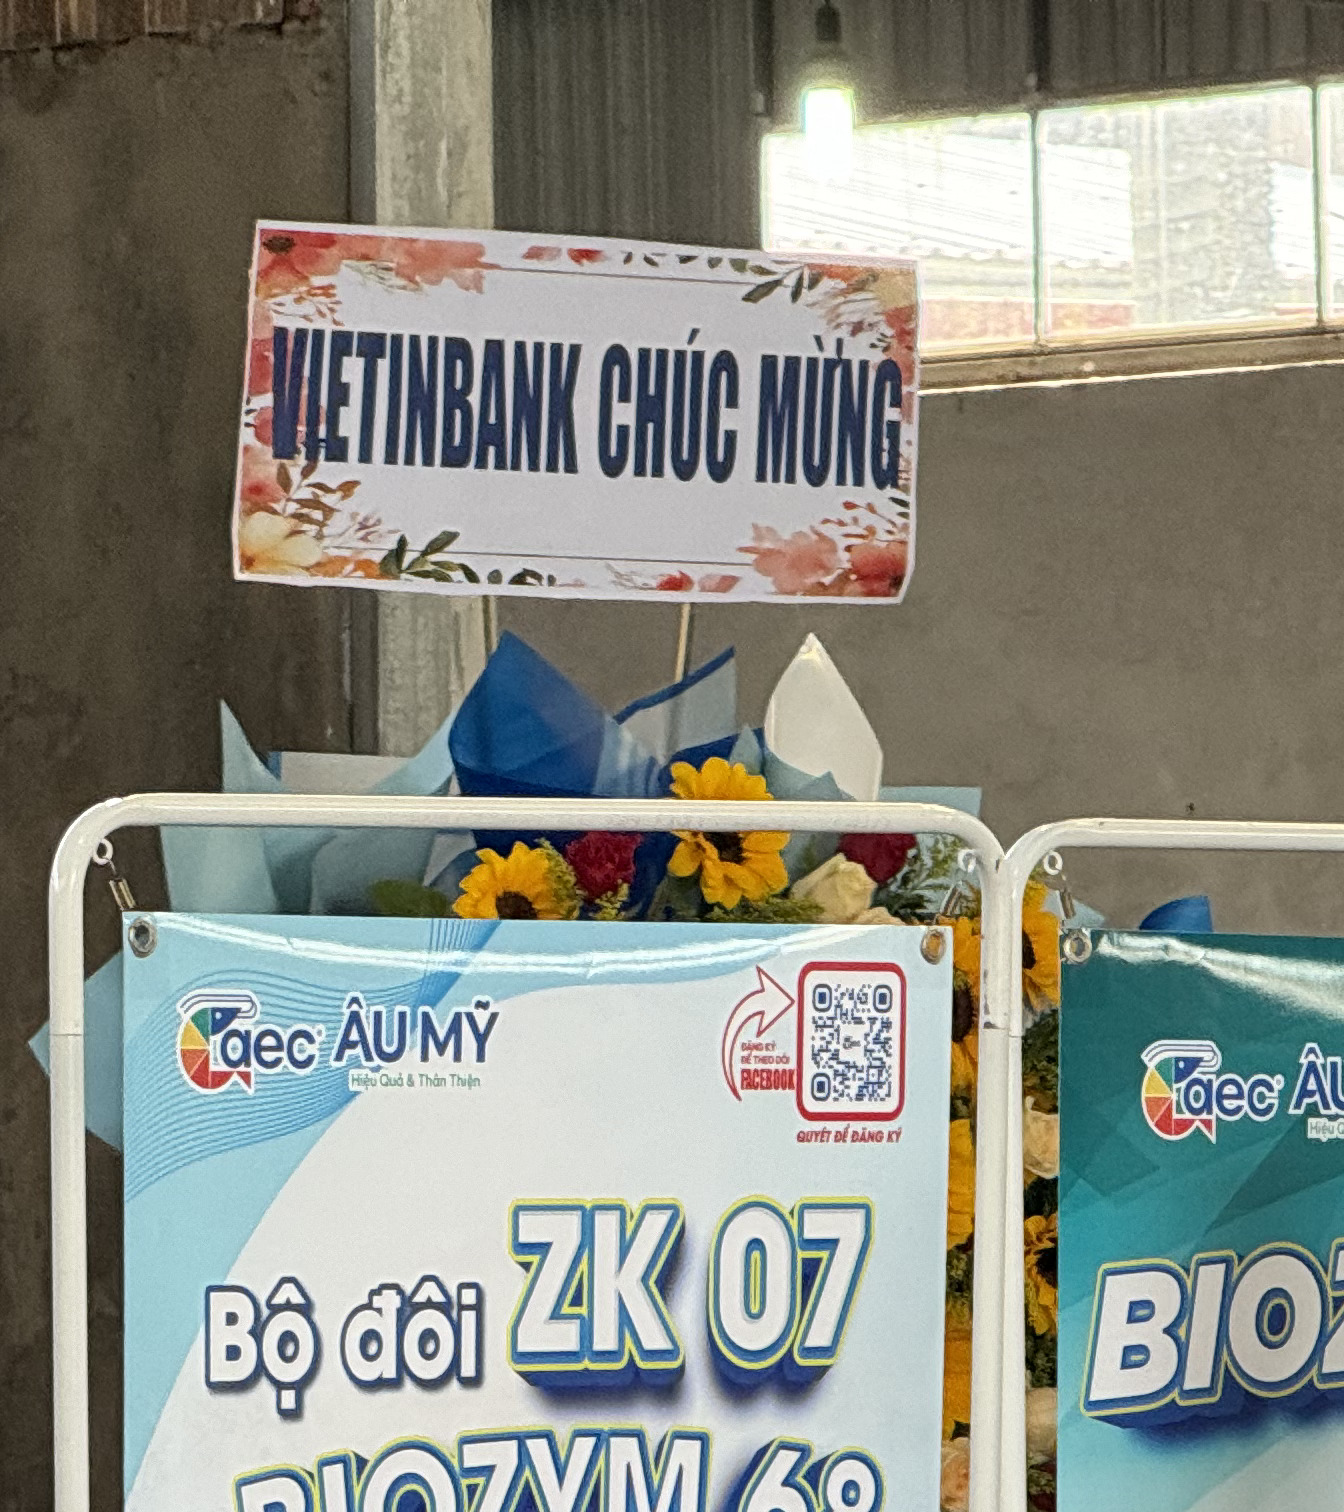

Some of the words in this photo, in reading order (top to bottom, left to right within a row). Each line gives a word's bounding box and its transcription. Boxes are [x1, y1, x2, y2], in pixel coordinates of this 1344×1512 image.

[271, 326, 582, 475] VIETINBANK
[599, 328, 739, 484] CHÚC
[755, 335, 901, 490] MỪNG
[332, 996, 408, 1064] ÂU
[420, 999, 500, 1064] MỸ
[379, 1072, 404, 1088] Quả
[406, 1073, 415, 1087] &
[449, 1072, 481, 1090] Thiện
[741, 1068, 796, 1091] FACEBOOK
[851, 1126, 885, 1144] ĐĂNG
[887, 1126, 903, 1144] KÝ
[205, 1277, 321, 1416] Bộ
[341, 1274, 484, 1388] đôi
[508, 1197, 686, 1374] ZK
[708, 1194, 875, 1372] 07
